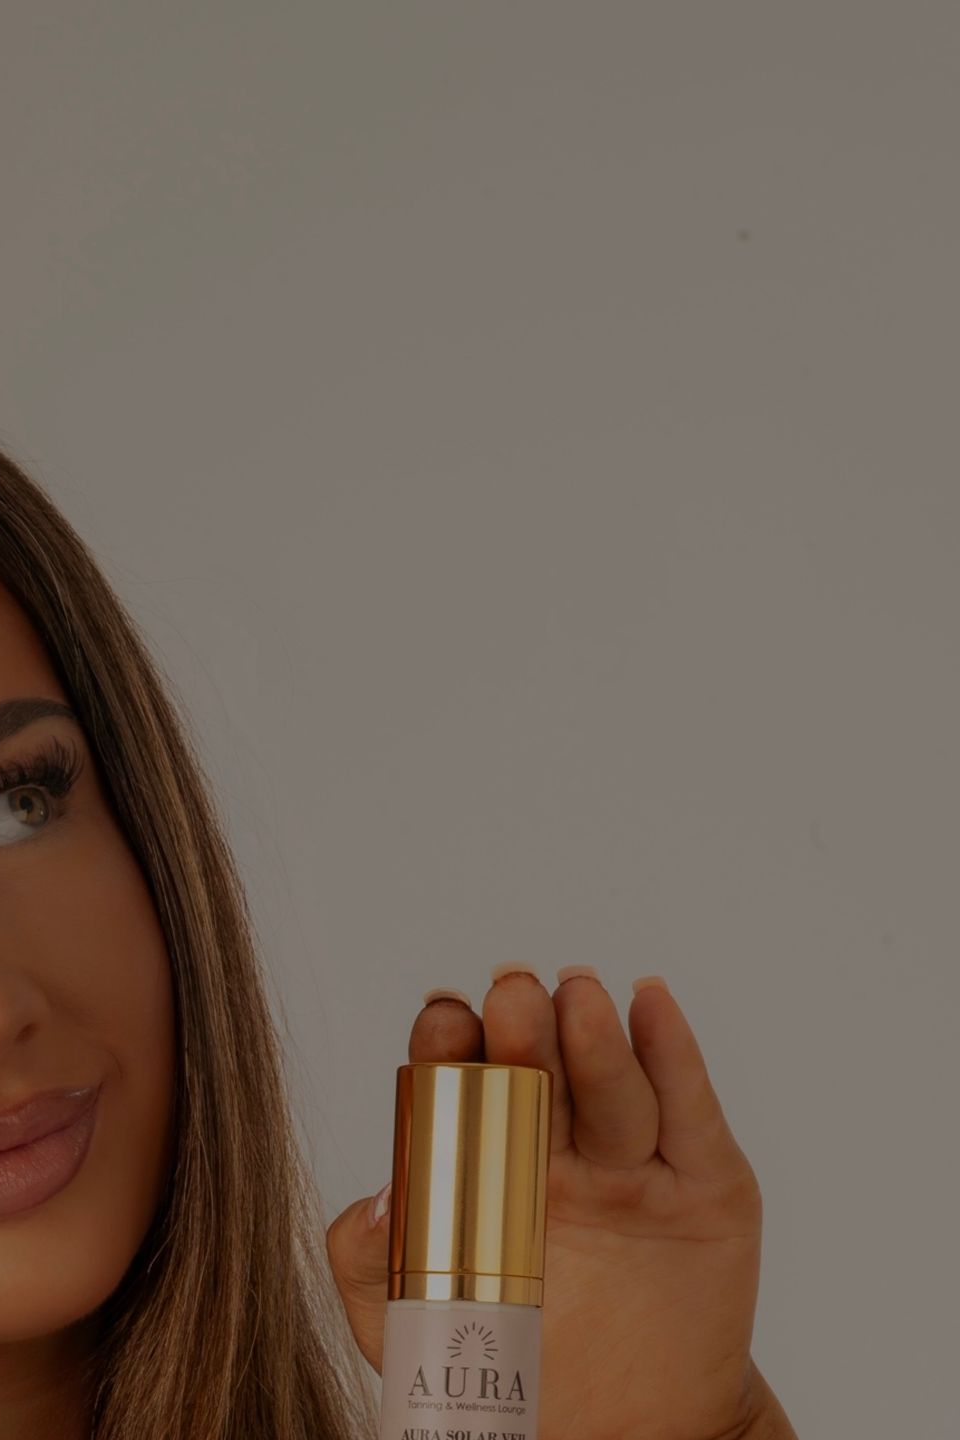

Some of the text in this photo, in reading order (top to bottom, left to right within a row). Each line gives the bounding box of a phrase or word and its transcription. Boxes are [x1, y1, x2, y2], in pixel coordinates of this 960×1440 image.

[408, 1365, 527, 1401] AURA
[408, 1400, 527, 1416] Tanning & Wellness Lounge
